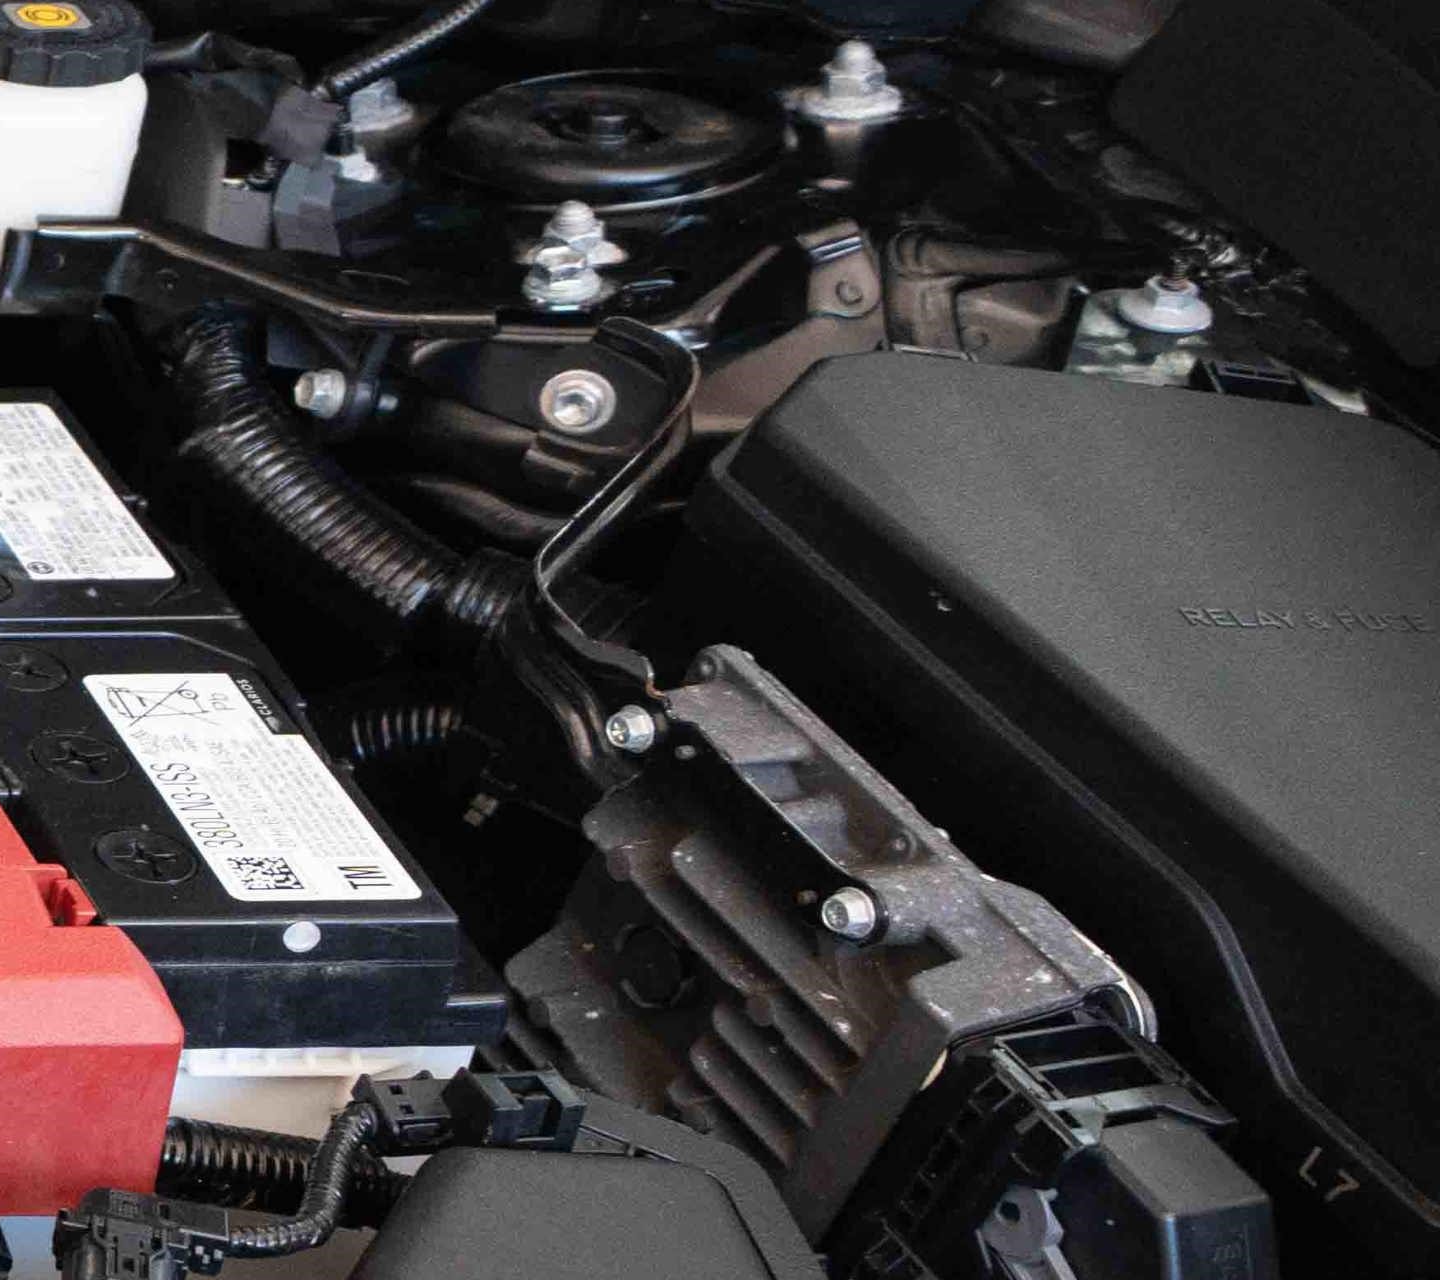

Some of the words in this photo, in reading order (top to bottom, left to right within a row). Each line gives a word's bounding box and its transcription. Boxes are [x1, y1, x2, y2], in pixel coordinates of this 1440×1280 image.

[1179, 607, 1296, 631] RELAY
[1333, 607, 1433, 633] FUSE
[235, 679, 273, 716] CLARIOS
[150, 762, 243, 848] 380LN3-ISS
[337, 865, 393, 890] TM
